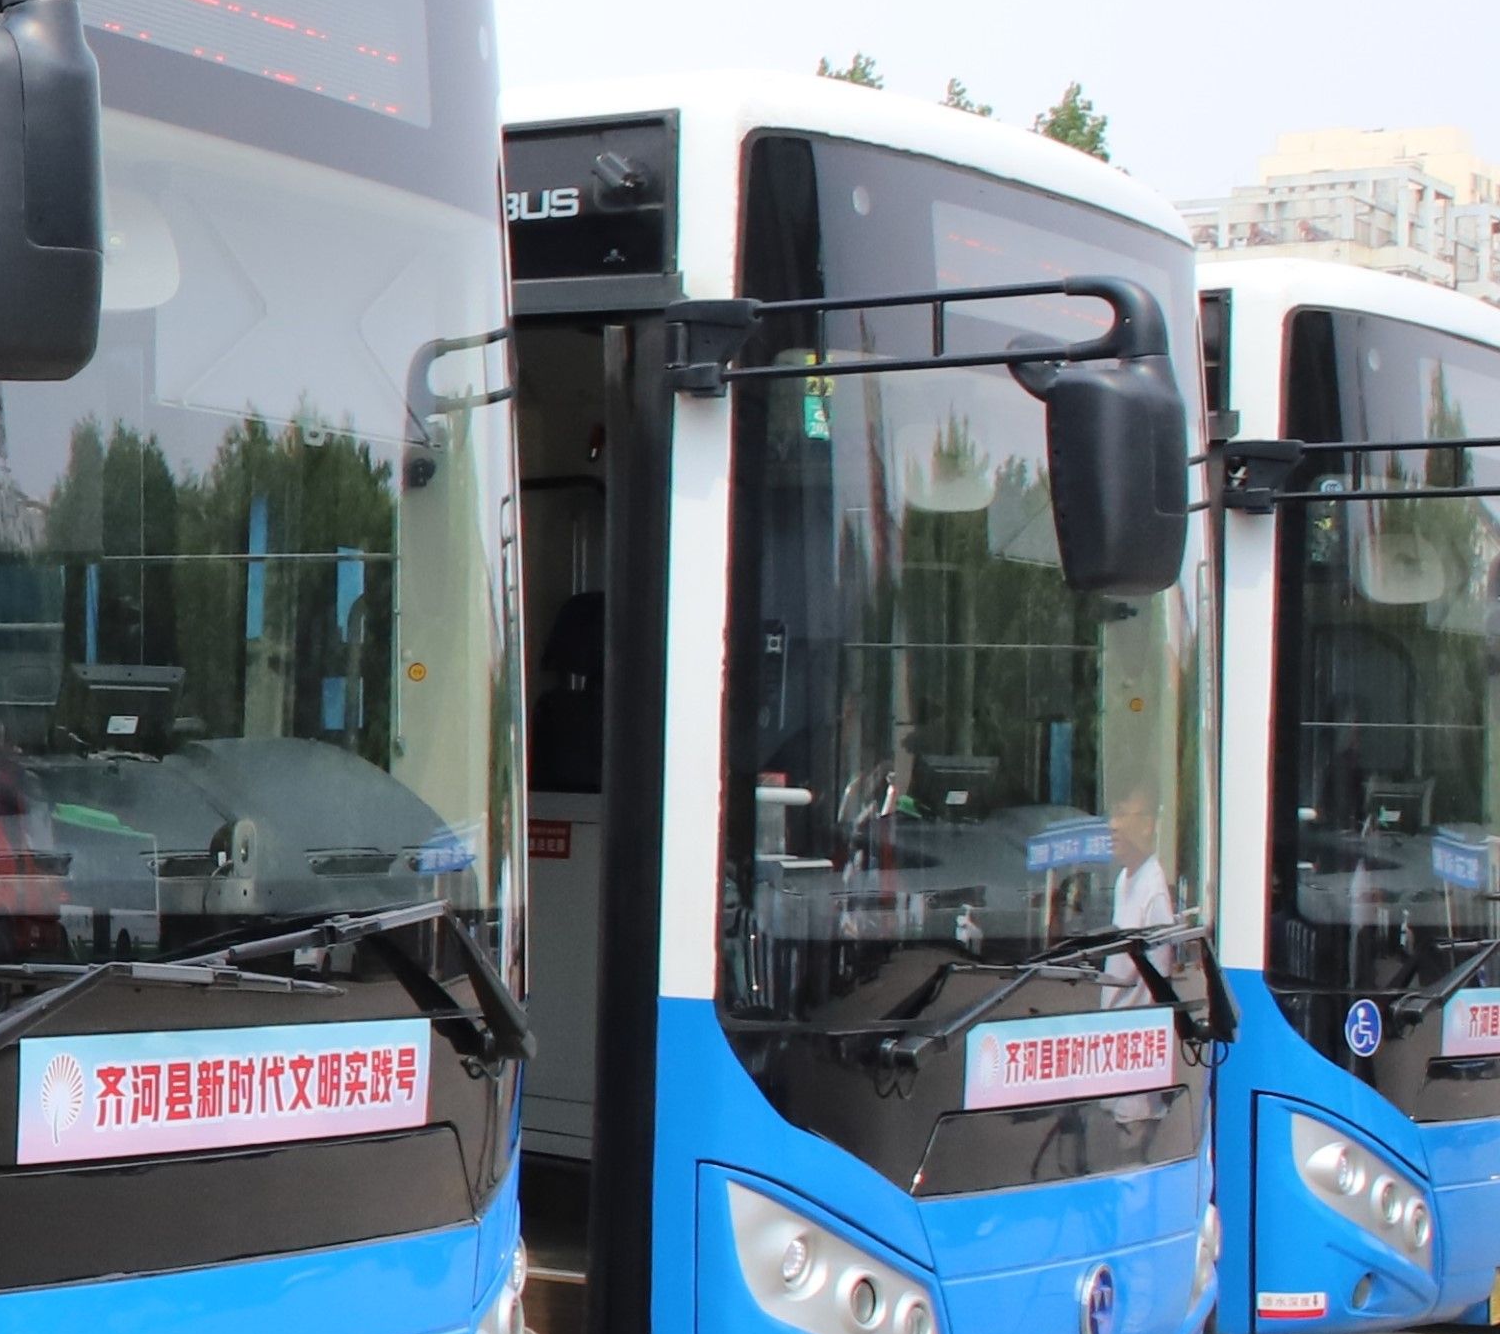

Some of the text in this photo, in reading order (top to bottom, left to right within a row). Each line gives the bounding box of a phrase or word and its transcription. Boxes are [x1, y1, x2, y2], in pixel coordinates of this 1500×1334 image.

[96, 1048, 417, 1128] 齐河县新时代文明实践号
[1005, 1028, 1167, 1084] 齐河县新时代文明实践号
